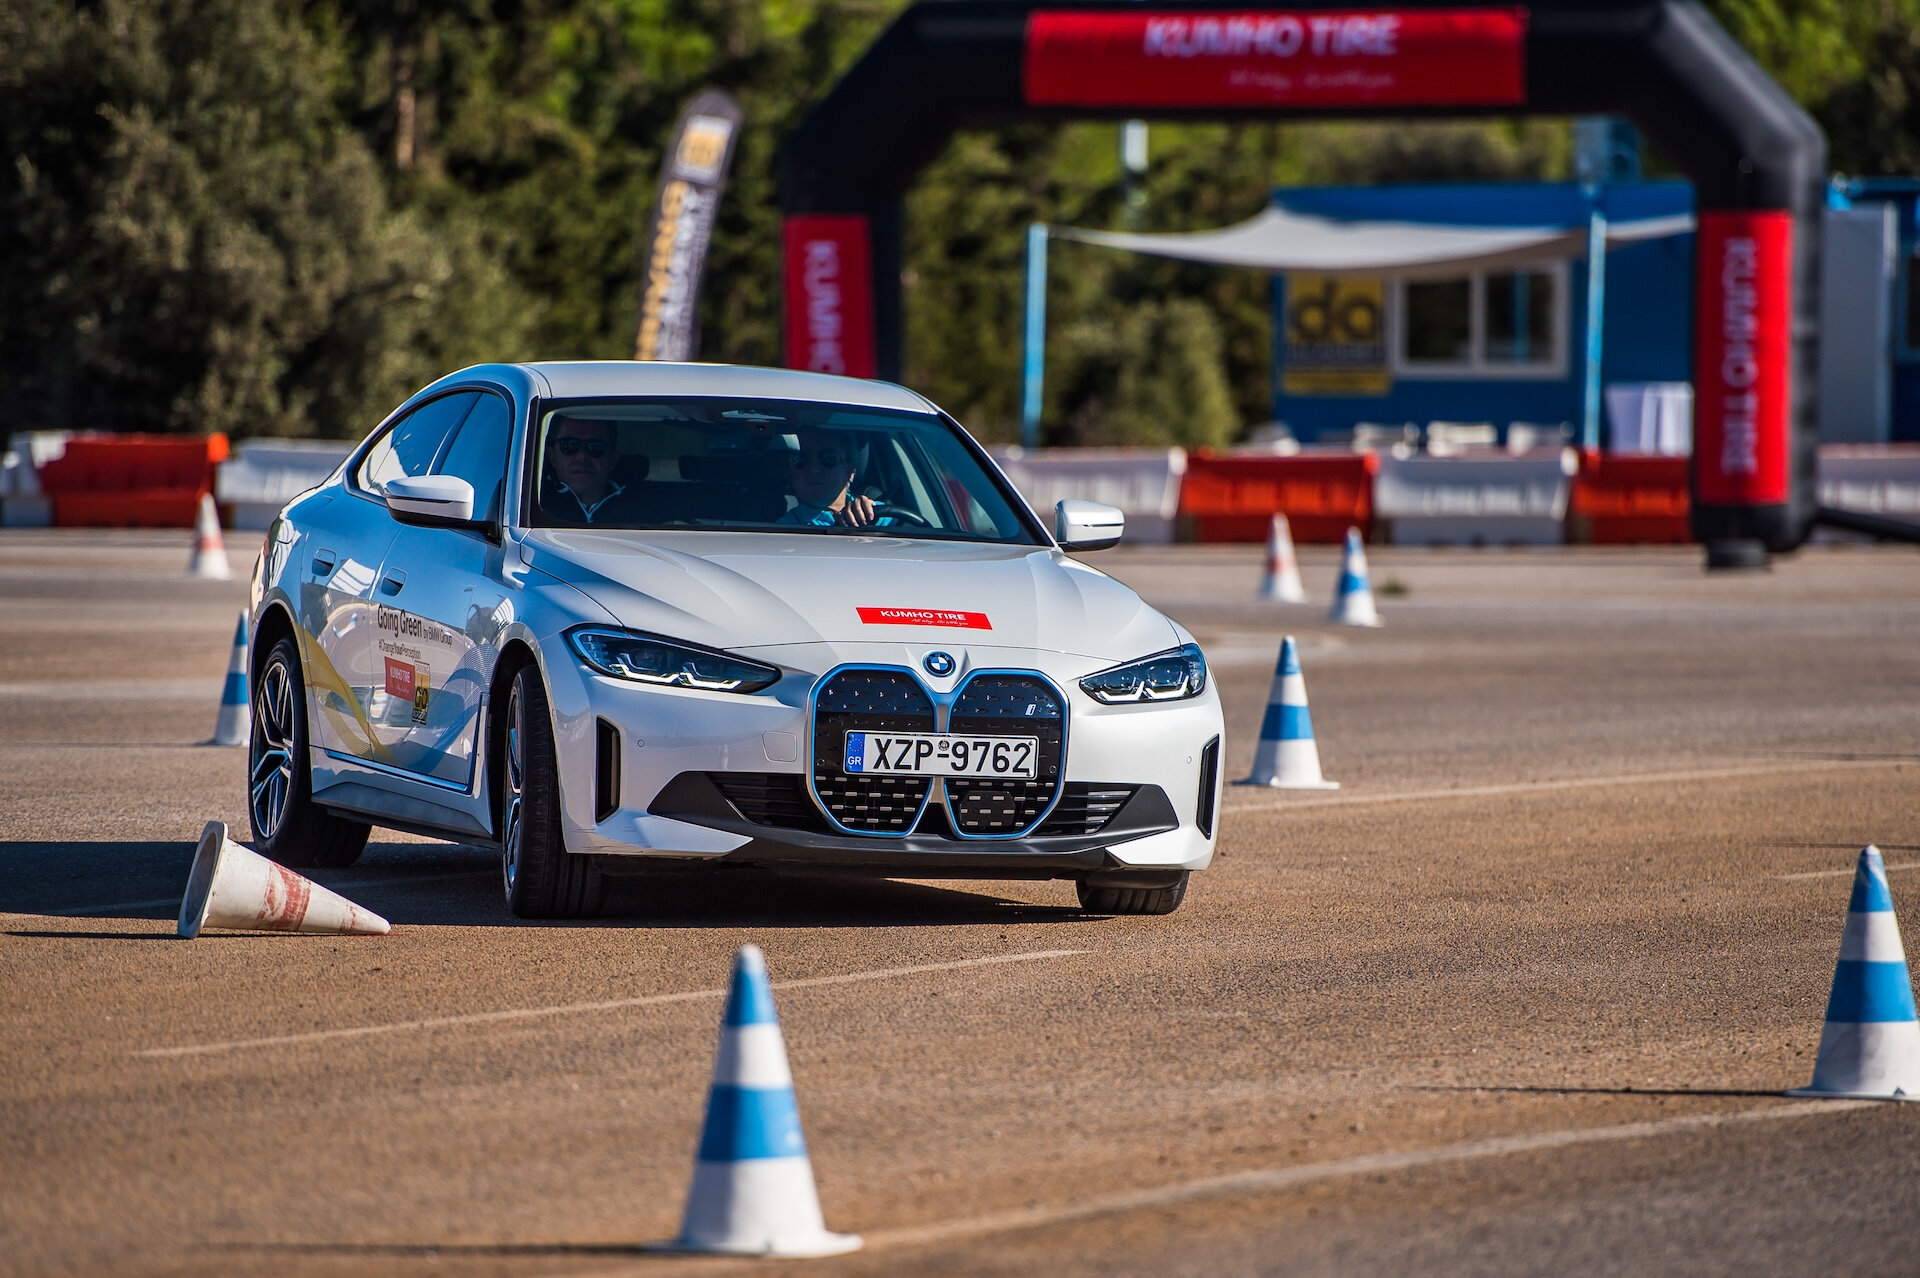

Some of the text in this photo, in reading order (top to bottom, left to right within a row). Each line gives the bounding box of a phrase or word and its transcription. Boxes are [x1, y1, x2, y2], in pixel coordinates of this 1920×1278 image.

[1144, 15, 1400, 57] KUMHO TIRE
[1721, 238, 1759, 475] KUMHO TIRE
[377, 604, 399, 638] Going
[400, 609, 422, 638] Green
[429, 627, 440, 642] BMW
[440, 629, 453, 647] Group
[847, 756, 862, 766] GR
[873, 738, 1032, 774] XZP-9762
